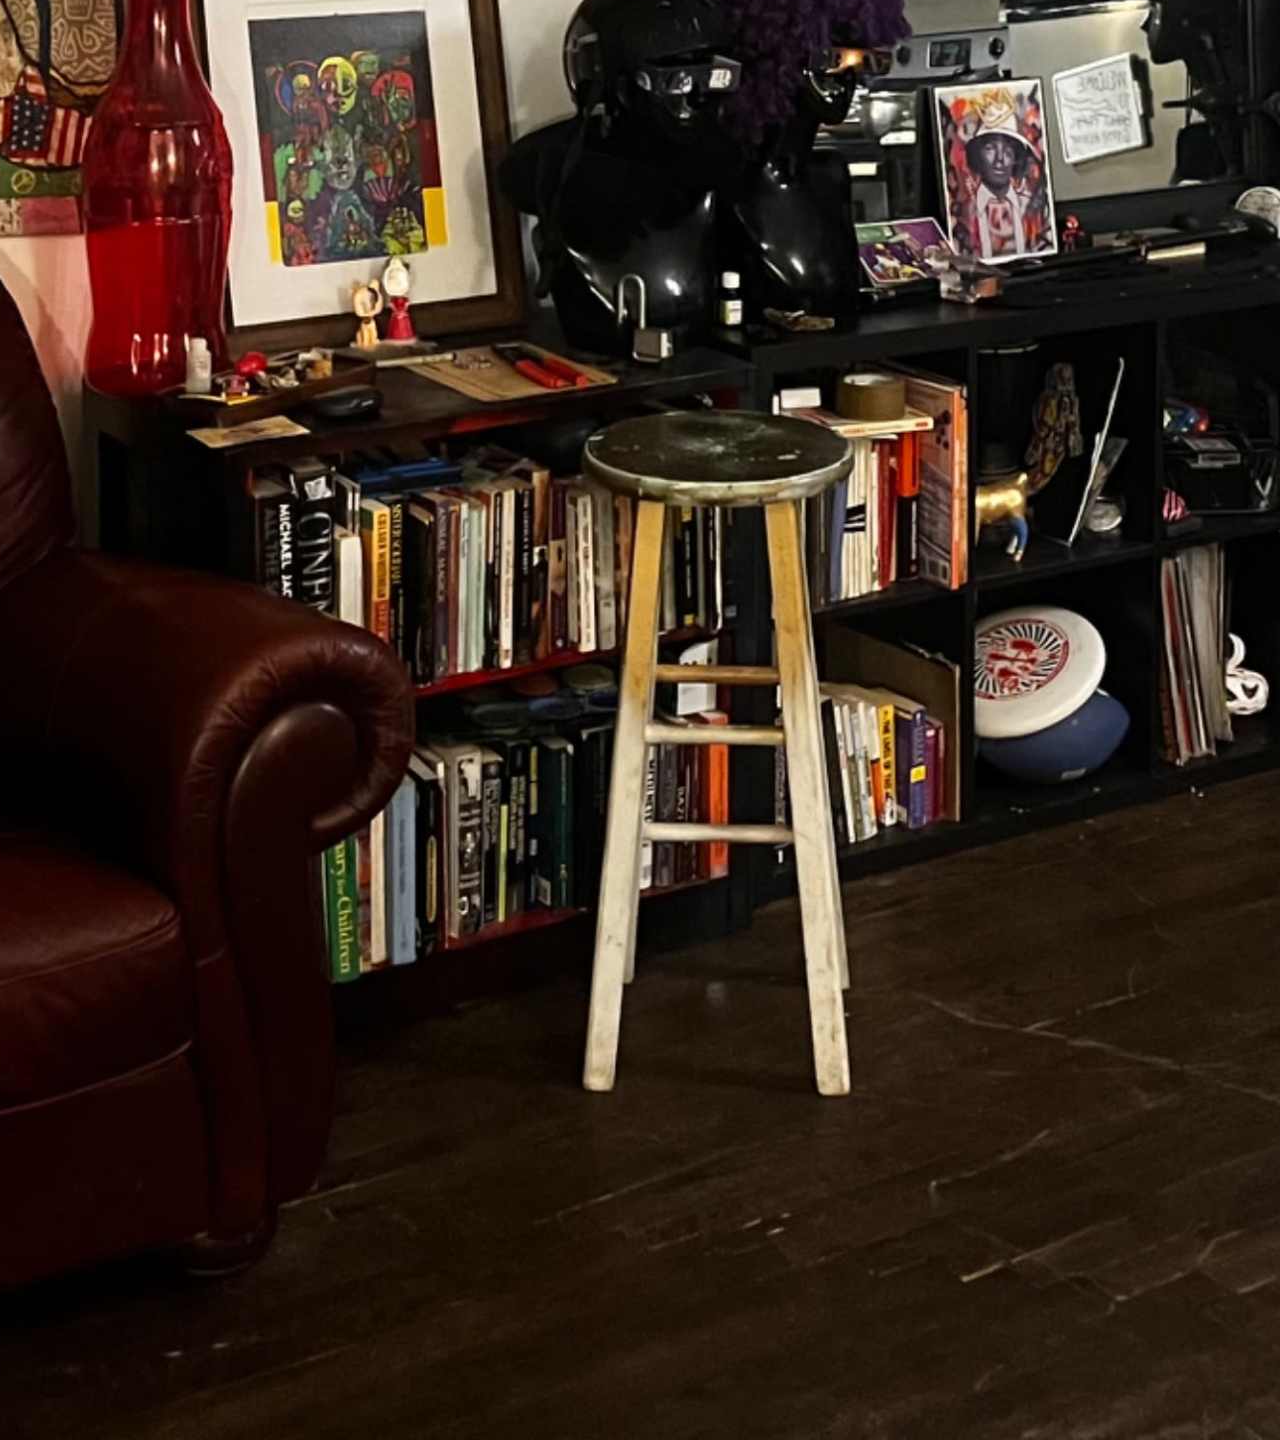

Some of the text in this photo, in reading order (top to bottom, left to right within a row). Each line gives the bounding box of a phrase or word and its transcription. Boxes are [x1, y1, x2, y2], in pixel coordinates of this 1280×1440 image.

[278, 503, 293, 599] MICHAEL JAC
[336, 896, 354, 975] Children
